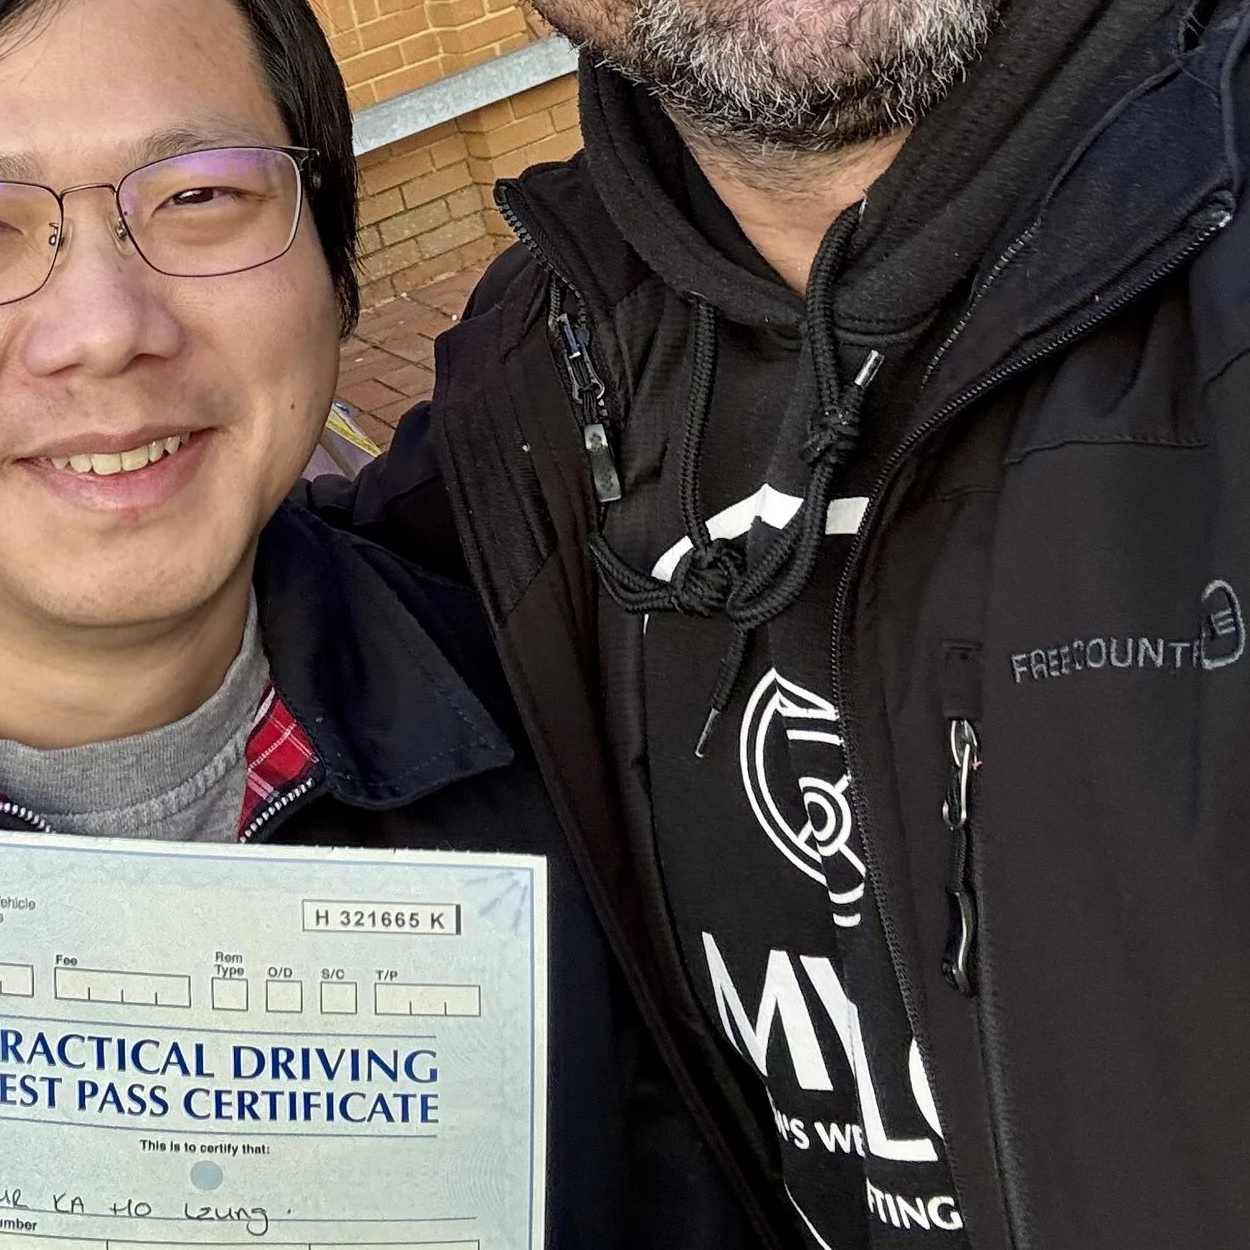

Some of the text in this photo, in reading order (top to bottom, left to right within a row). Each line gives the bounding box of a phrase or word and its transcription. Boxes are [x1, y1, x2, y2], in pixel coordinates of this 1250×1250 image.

[315, 908, 445, 929] H 321665 K
[55, 954, 78, 967] Fee
[215, 951, 243, 965] Rem
[214, 964, 245, 979] Type
[267, 966, 293, 979] O/D
[321, 967, 346, 981] S/C
[375, 969, 399, 982] T/P
[232, 1044, 439, 1084] DRIVING
[77, 1077, 170, 1119] PASS
[183, 1086, 439, 1125] CERTIFICATE
[139, 1139, 166, 1151] This
[170, 1140, 180, 1153] is
[184, 1141, 196, 1154] to
[200, 1142, 238, 1157] certify
[53, 1194, 85, 1214] KA
